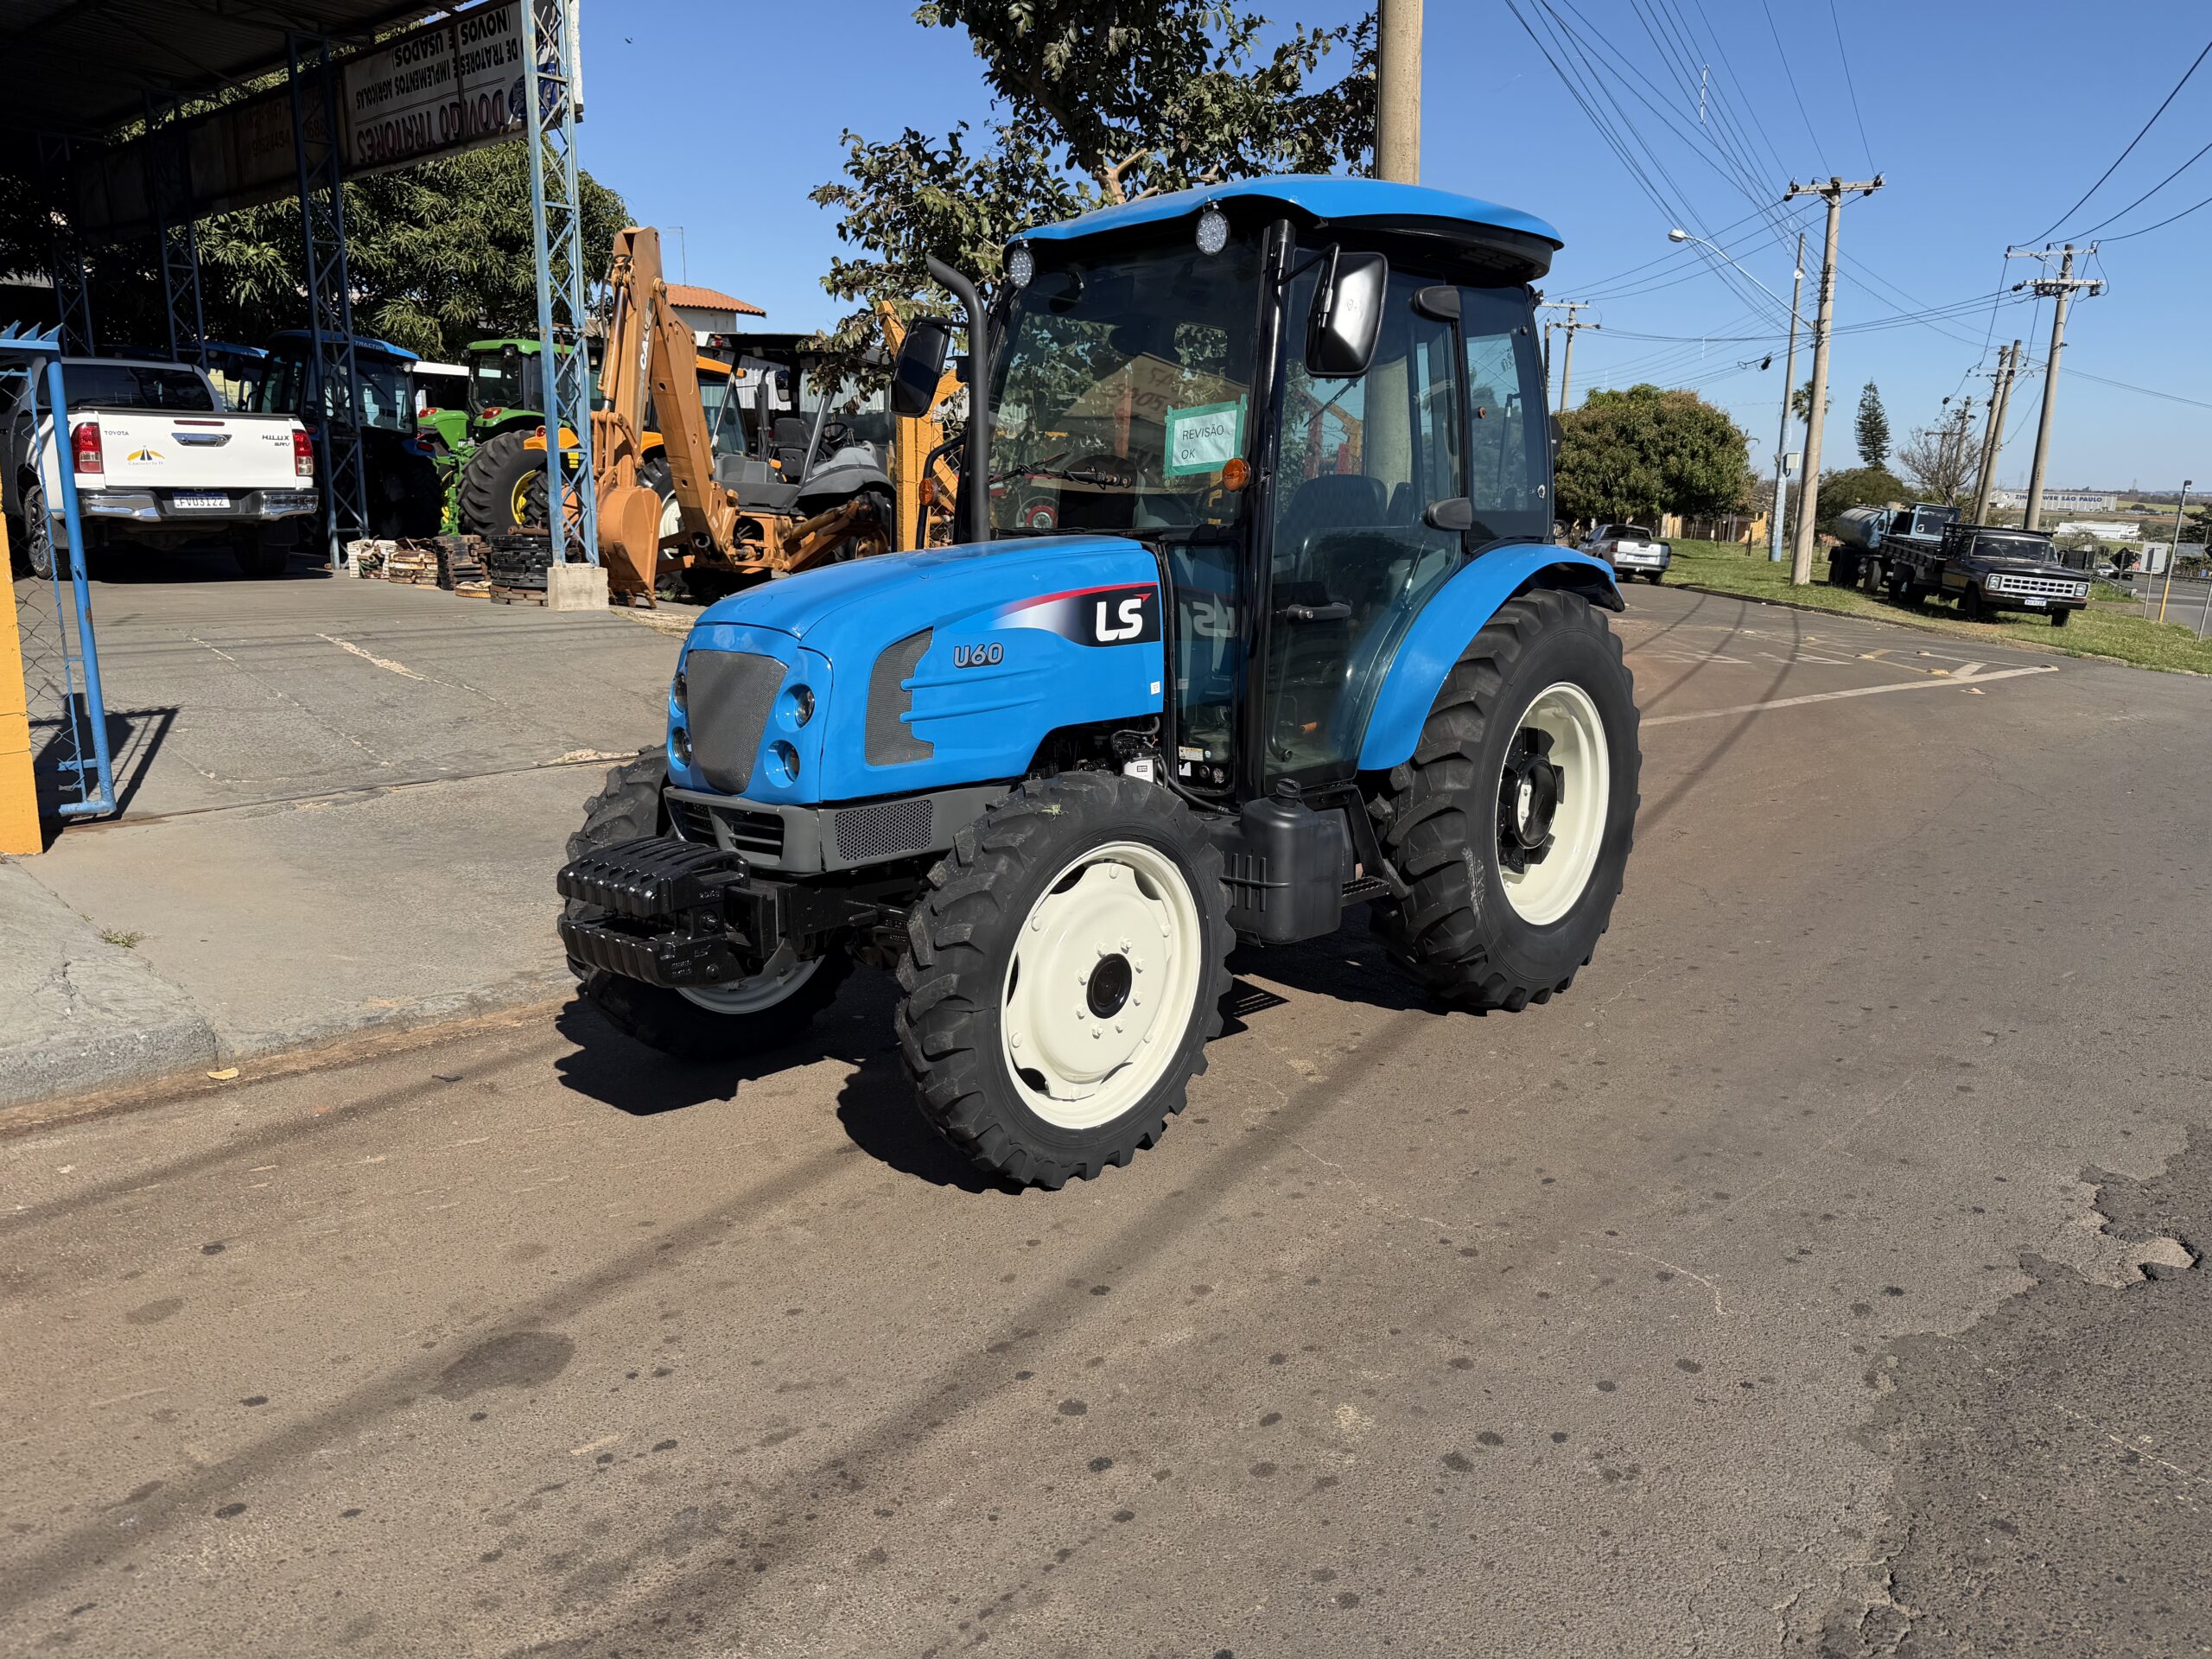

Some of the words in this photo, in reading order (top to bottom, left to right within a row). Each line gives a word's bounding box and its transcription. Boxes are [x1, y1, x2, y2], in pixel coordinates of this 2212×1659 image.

[461, 42, 505, 76] TRATORES
[507, 38, 518, 62] DE
[394, 59, 451, 95] IMPLEMENTOS
[356, 78, 392, 110] AGRÍCOLAS
[357, 111, 435, 162] TRATORES
[354, 340, 385, 352] TRACTOR
[639, 308, 652, 371] CASE
[1182, 423, 1224, 442] REVISÃO
[1180, 448, 1196, 461] OK
[1096, 598, 1143, 642] LS
[954, 642, 1004, 668] U60
